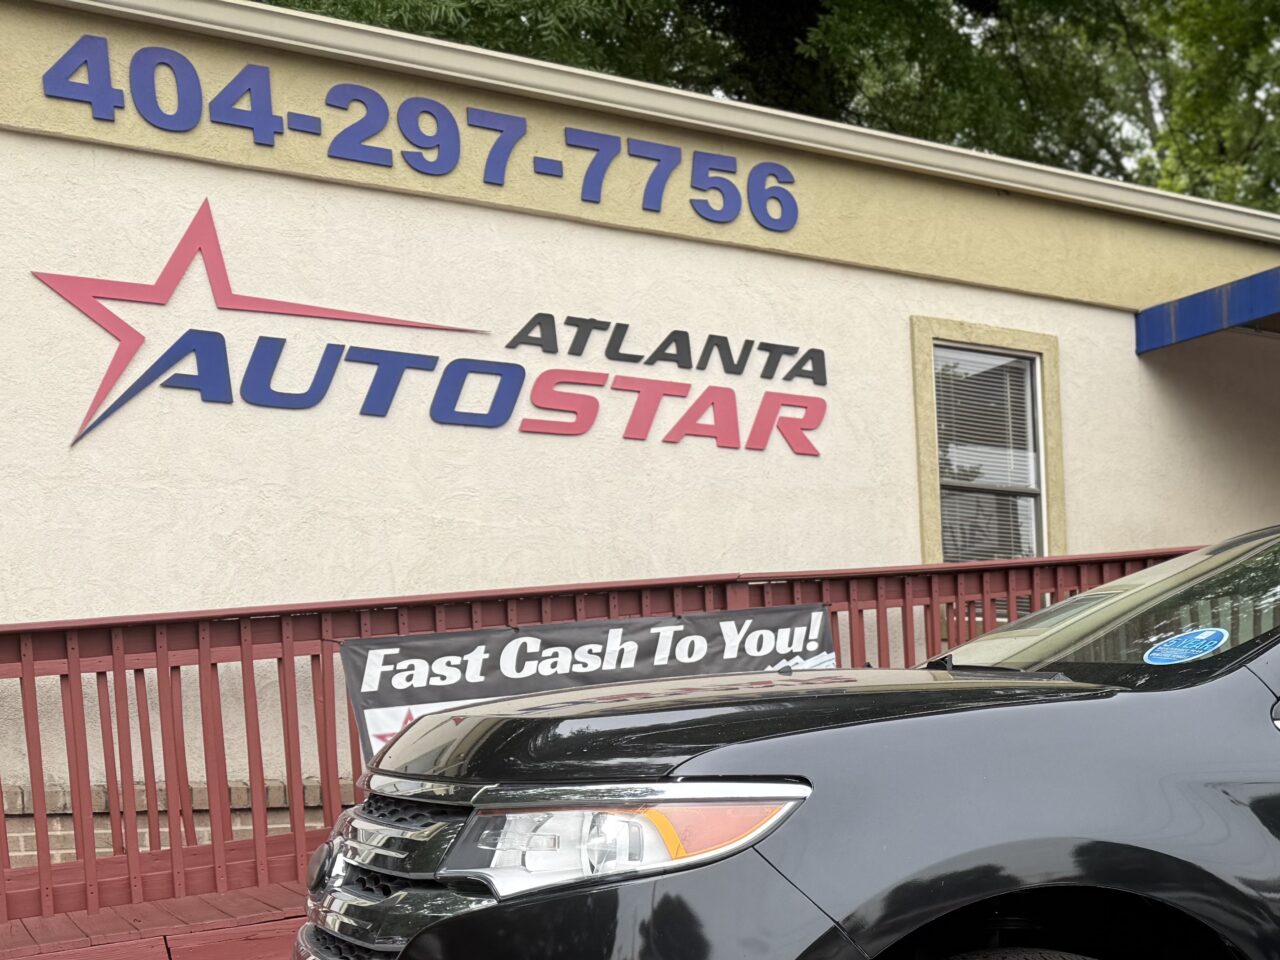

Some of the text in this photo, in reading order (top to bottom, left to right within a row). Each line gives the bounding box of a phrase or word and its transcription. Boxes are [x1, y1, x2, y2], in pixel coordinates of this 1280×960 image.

[42, 33, 800, 232] 404-297-7756
[506, 312, 828, 386] ATLANTA
[360, 611, 824, 693] Fast Cash To You!
